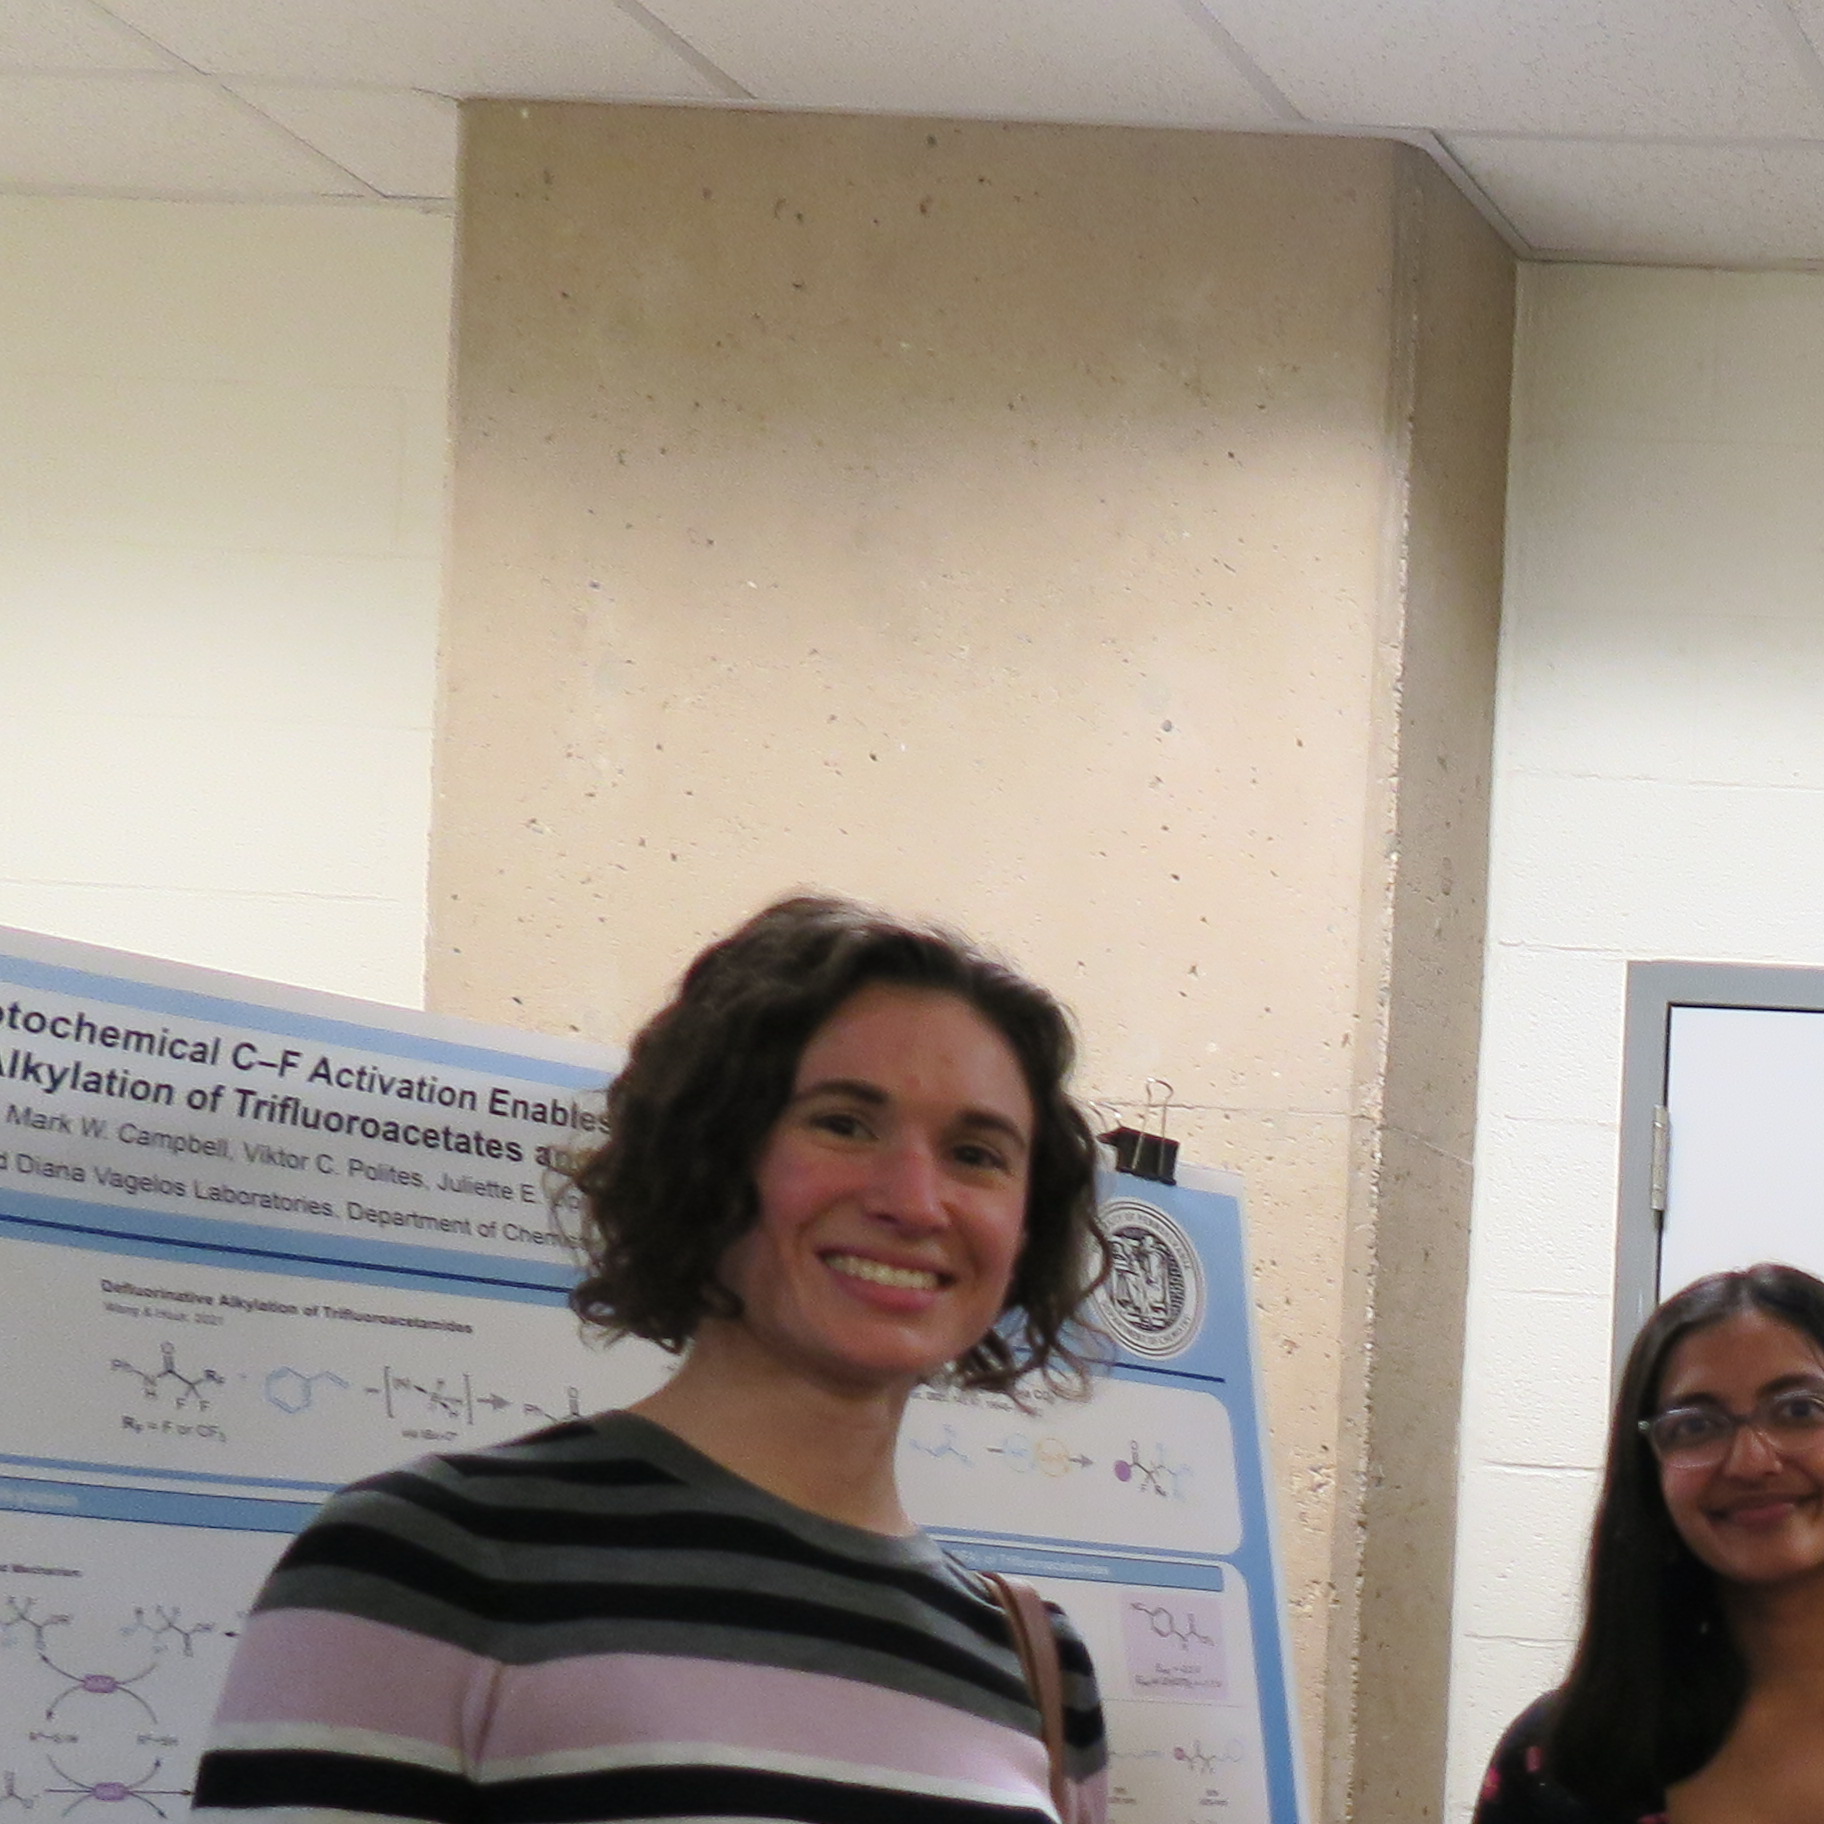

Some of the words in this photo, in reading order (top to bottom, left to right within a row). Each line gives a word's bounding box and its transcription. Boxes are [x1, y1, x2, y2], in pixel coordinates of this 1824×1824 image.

[0, 1000, 220, 1066] tochemical
[307, 1056, 478, 1112] Activation
[487, 1087, 610, 1135] Enables
[6, 1104, 71, 1135] Mark
[118, 1122, 233, 1160] Campbell,
[242, 1140, 309, 1171] Viktor
[315, 1154, 339, 1176] C.
[437, 1172, 513, 1201] Juliette
[186, 1084, 226, 1113] of
[235, 1087, 523, 1163] Trifluoroacetates
[16, 1153, 86, 1182] Diana
[93, 1165, 187, 1197] Vagelos
[346, 1202, 473, 1237] Department
[477, 1221, 498, 1239] of
